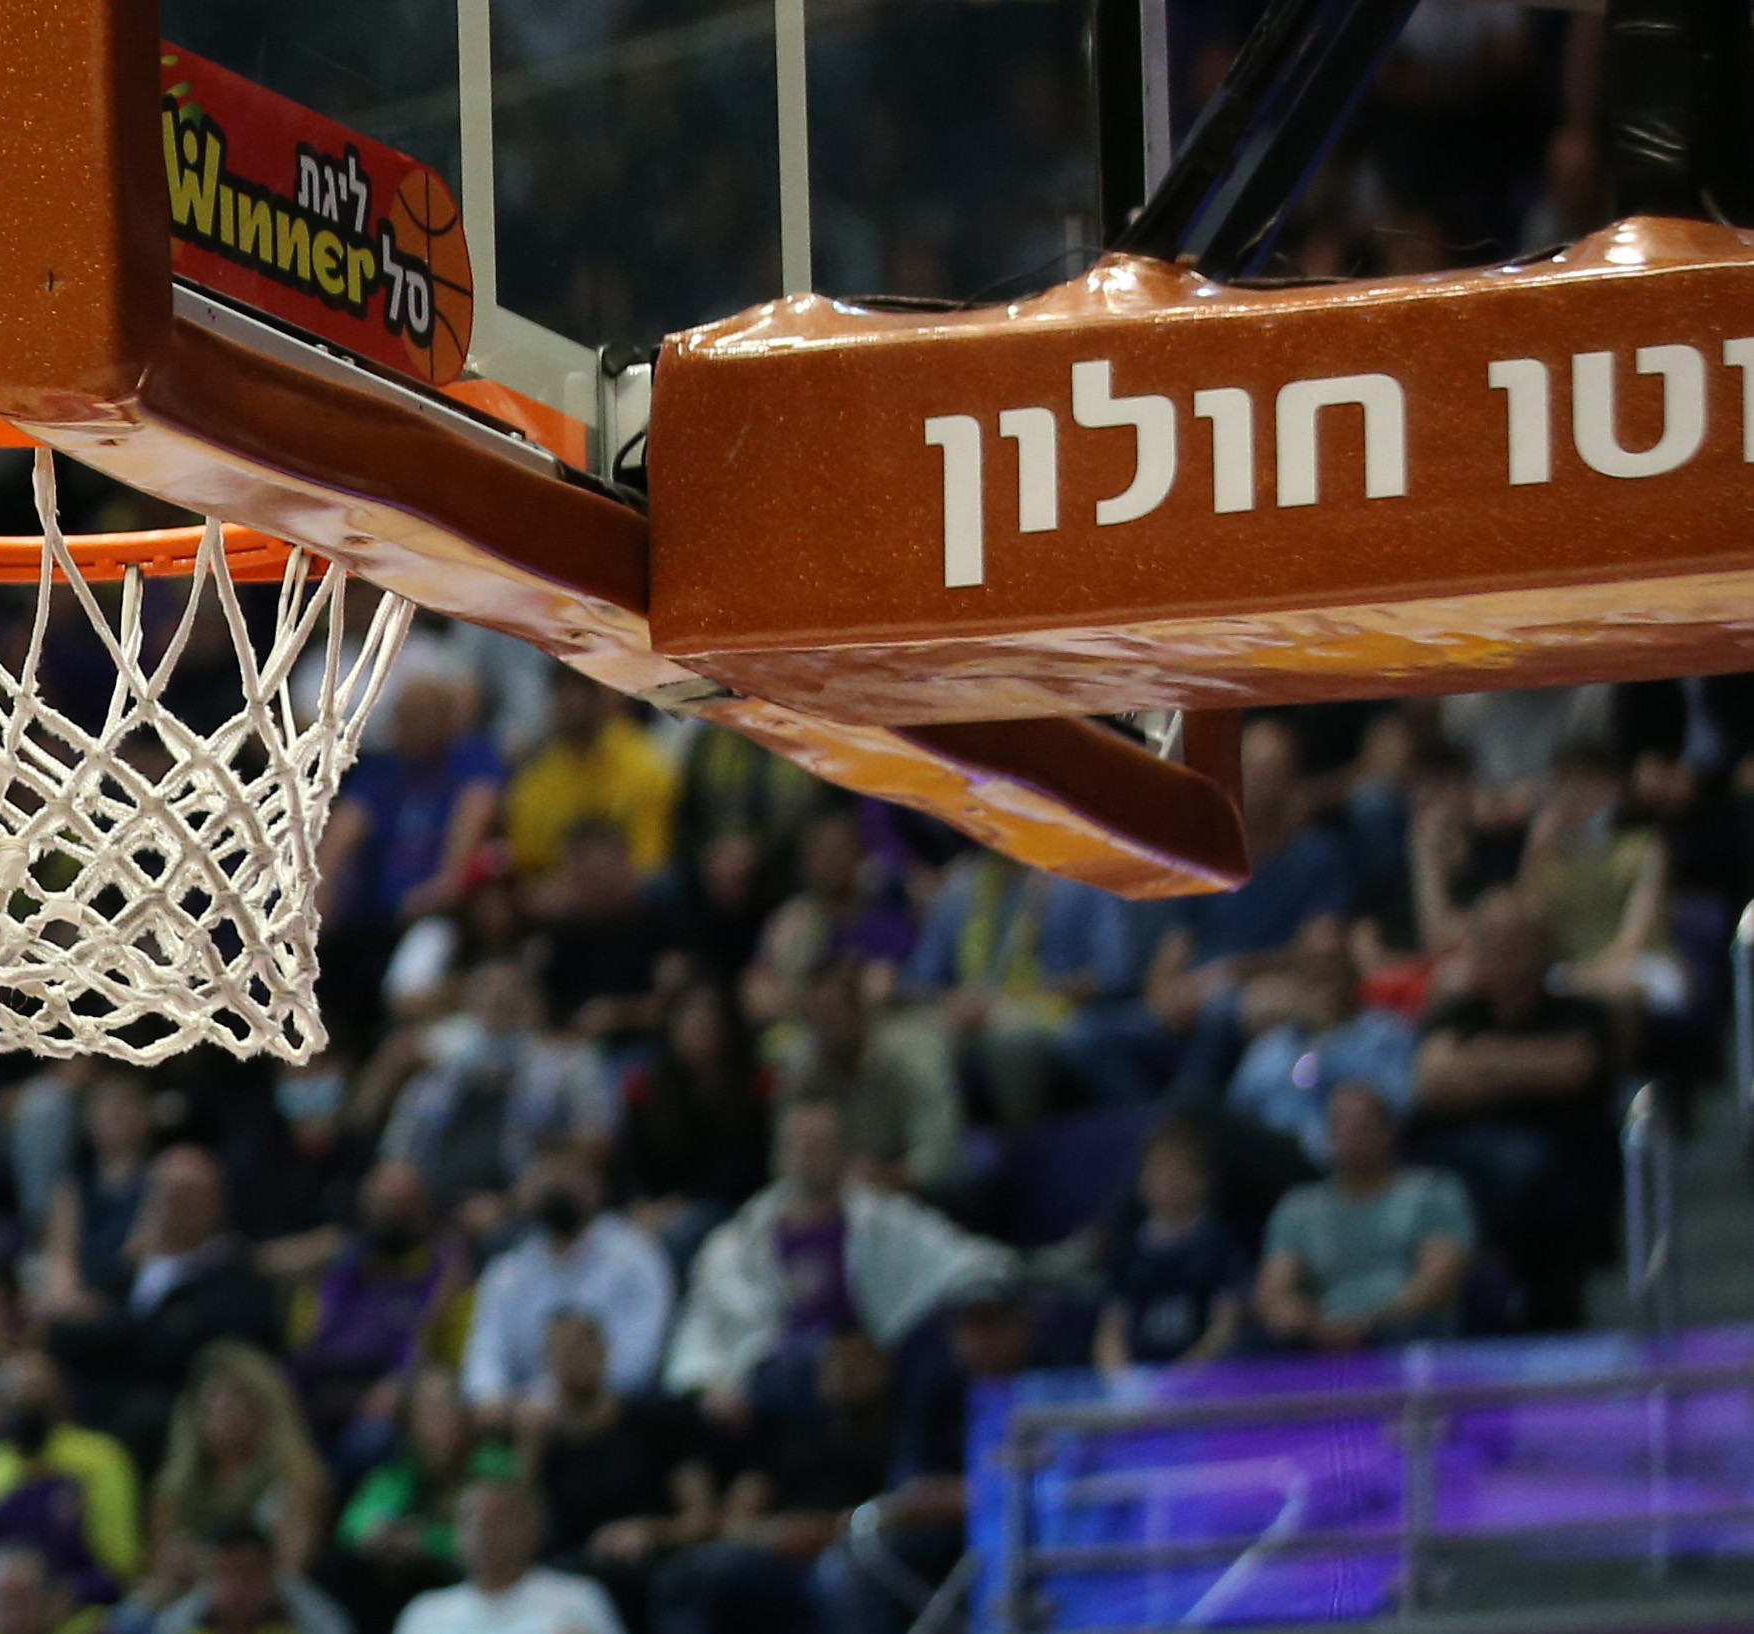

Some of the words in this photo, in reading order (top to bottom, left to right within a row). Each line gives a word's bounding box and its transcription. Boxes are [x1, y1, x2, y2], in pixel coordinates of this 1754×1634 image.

[161, 110, 376, 305] Winner
[381, 232, 430, 334] סל
[298, 153, 368, 233] ליגת
[924, 358, 1407, 589] חולון
